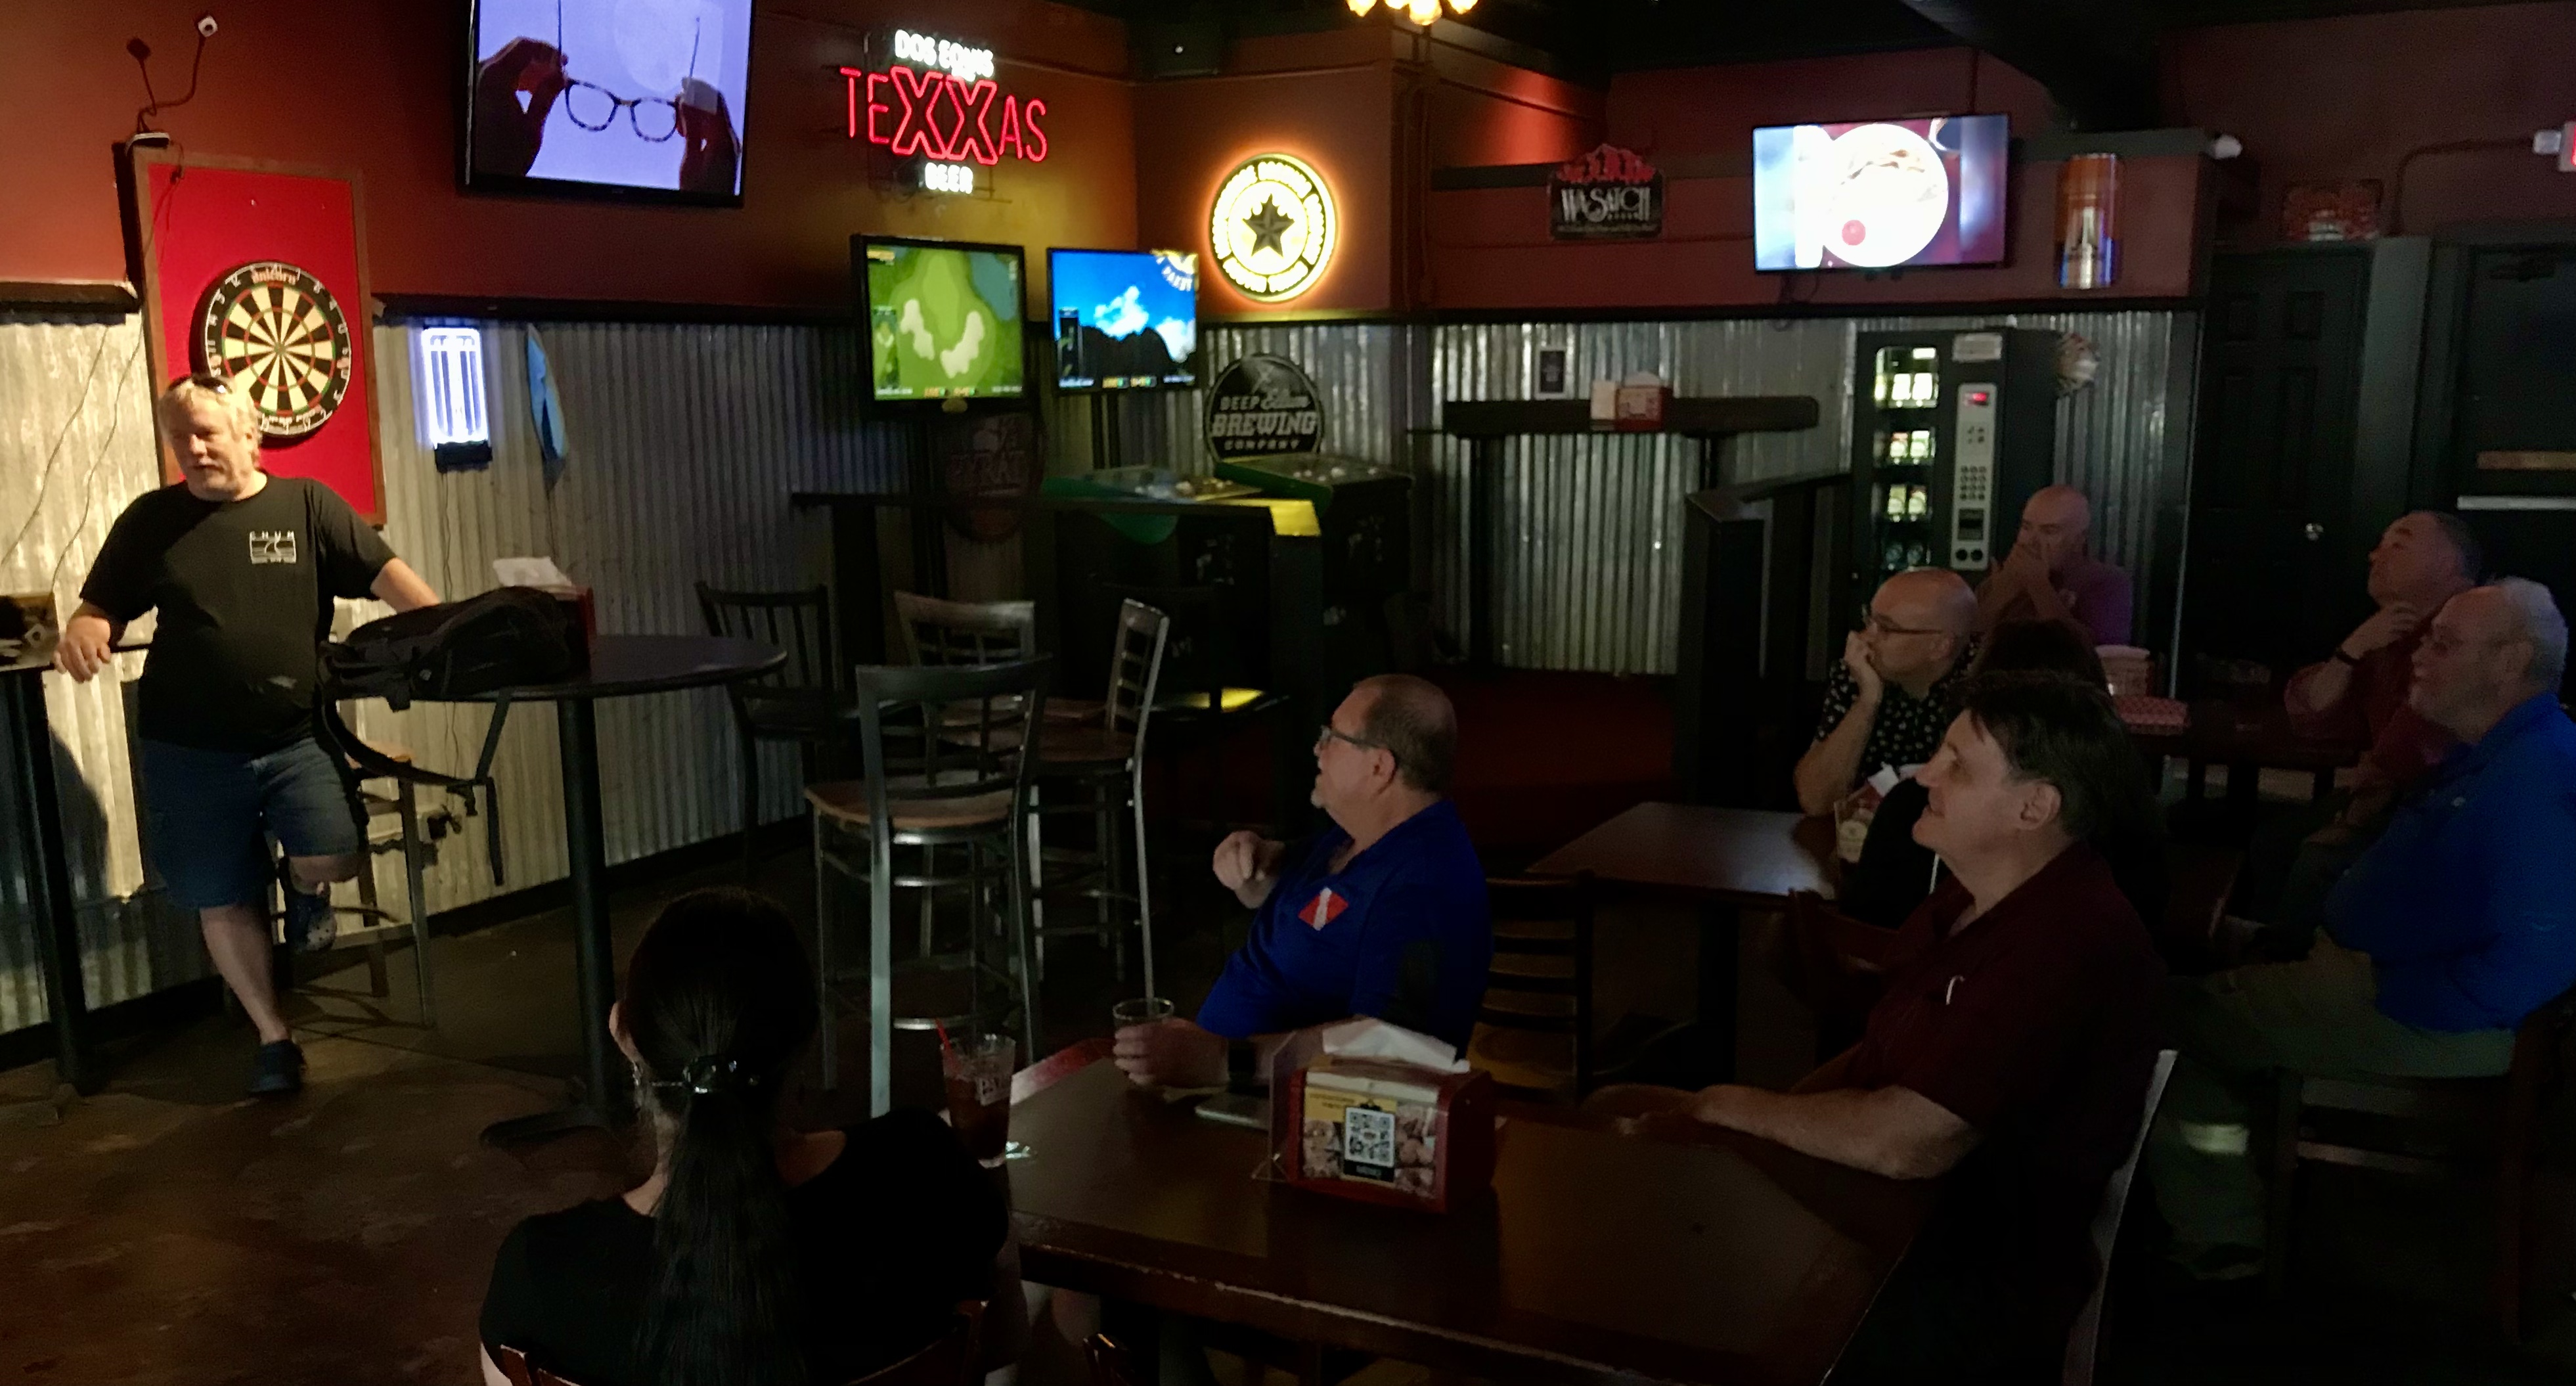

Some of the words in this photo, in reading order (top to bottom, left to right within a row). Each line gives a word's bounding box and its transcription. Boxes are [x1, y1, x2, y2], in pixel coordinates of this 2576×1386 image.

[895, 30, 937, 66] DOS
[1220, 395, 1260, 411] DEEP
[1212, 411, 1319, 437] BREWING
